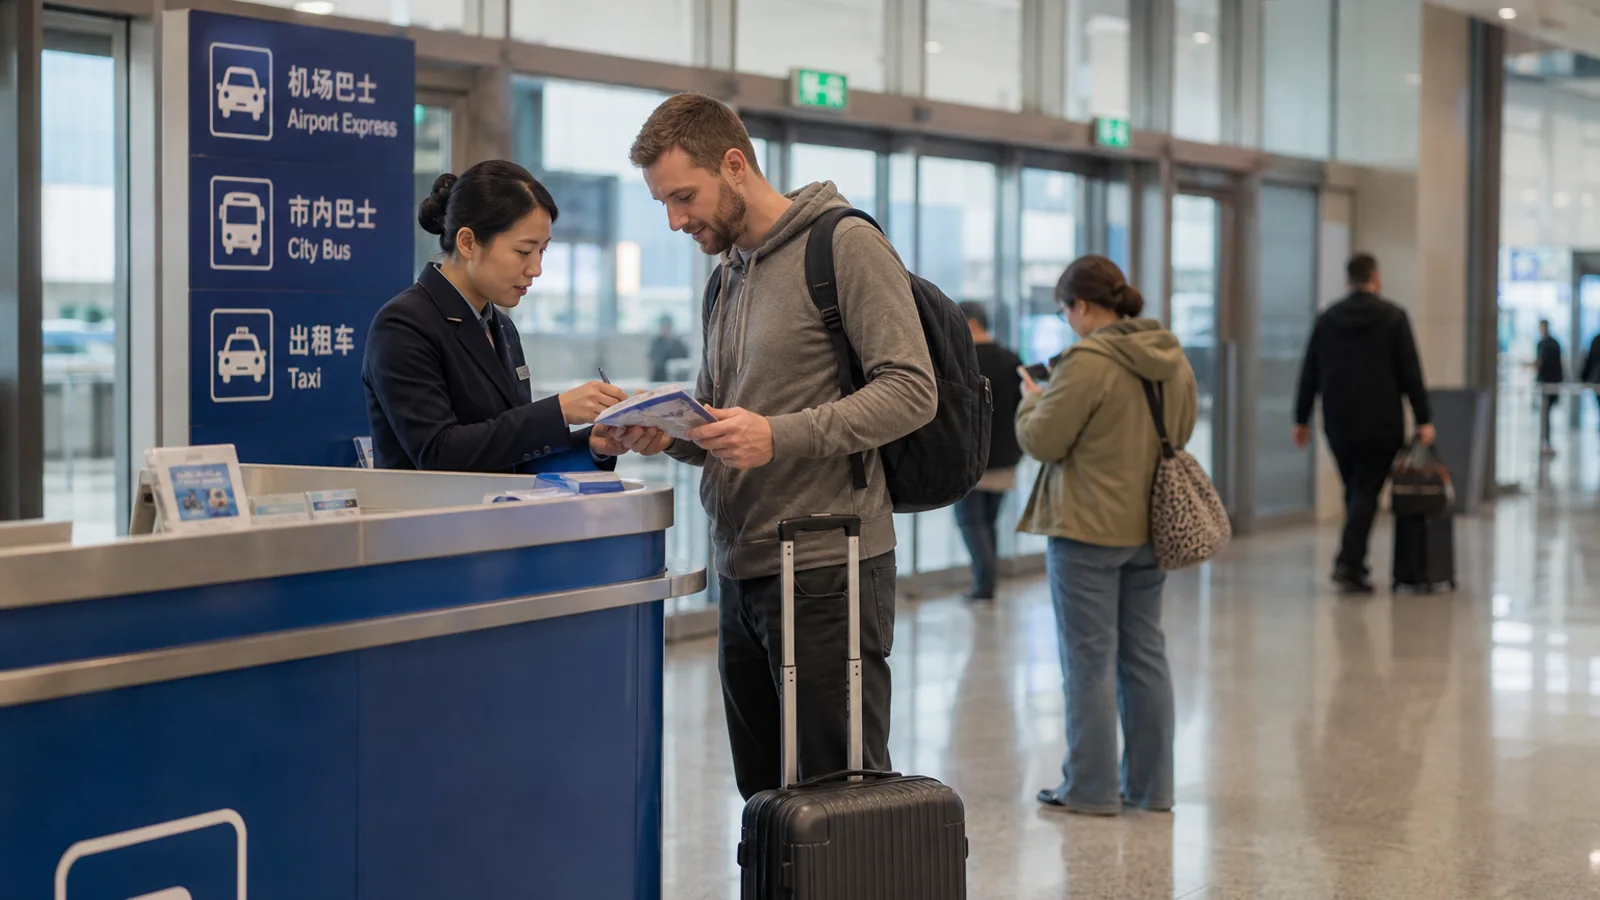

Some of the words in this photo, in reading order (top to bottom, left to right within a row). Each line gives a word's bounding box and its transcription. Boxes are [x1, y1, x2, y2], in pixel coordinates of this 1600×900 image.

[288, 65, 377, 104] 机场巴士
[287, 108, 339, 135] Airport
[342, 113, 398, 139] Express
[288, 195, 377, 229] 市内巴士
[288, 237, 318, 264] City
[323, 239, 351, 261] Bus
[289, 324, 355, 356] 出租车
[288, 367, 321, 389] Taxi
